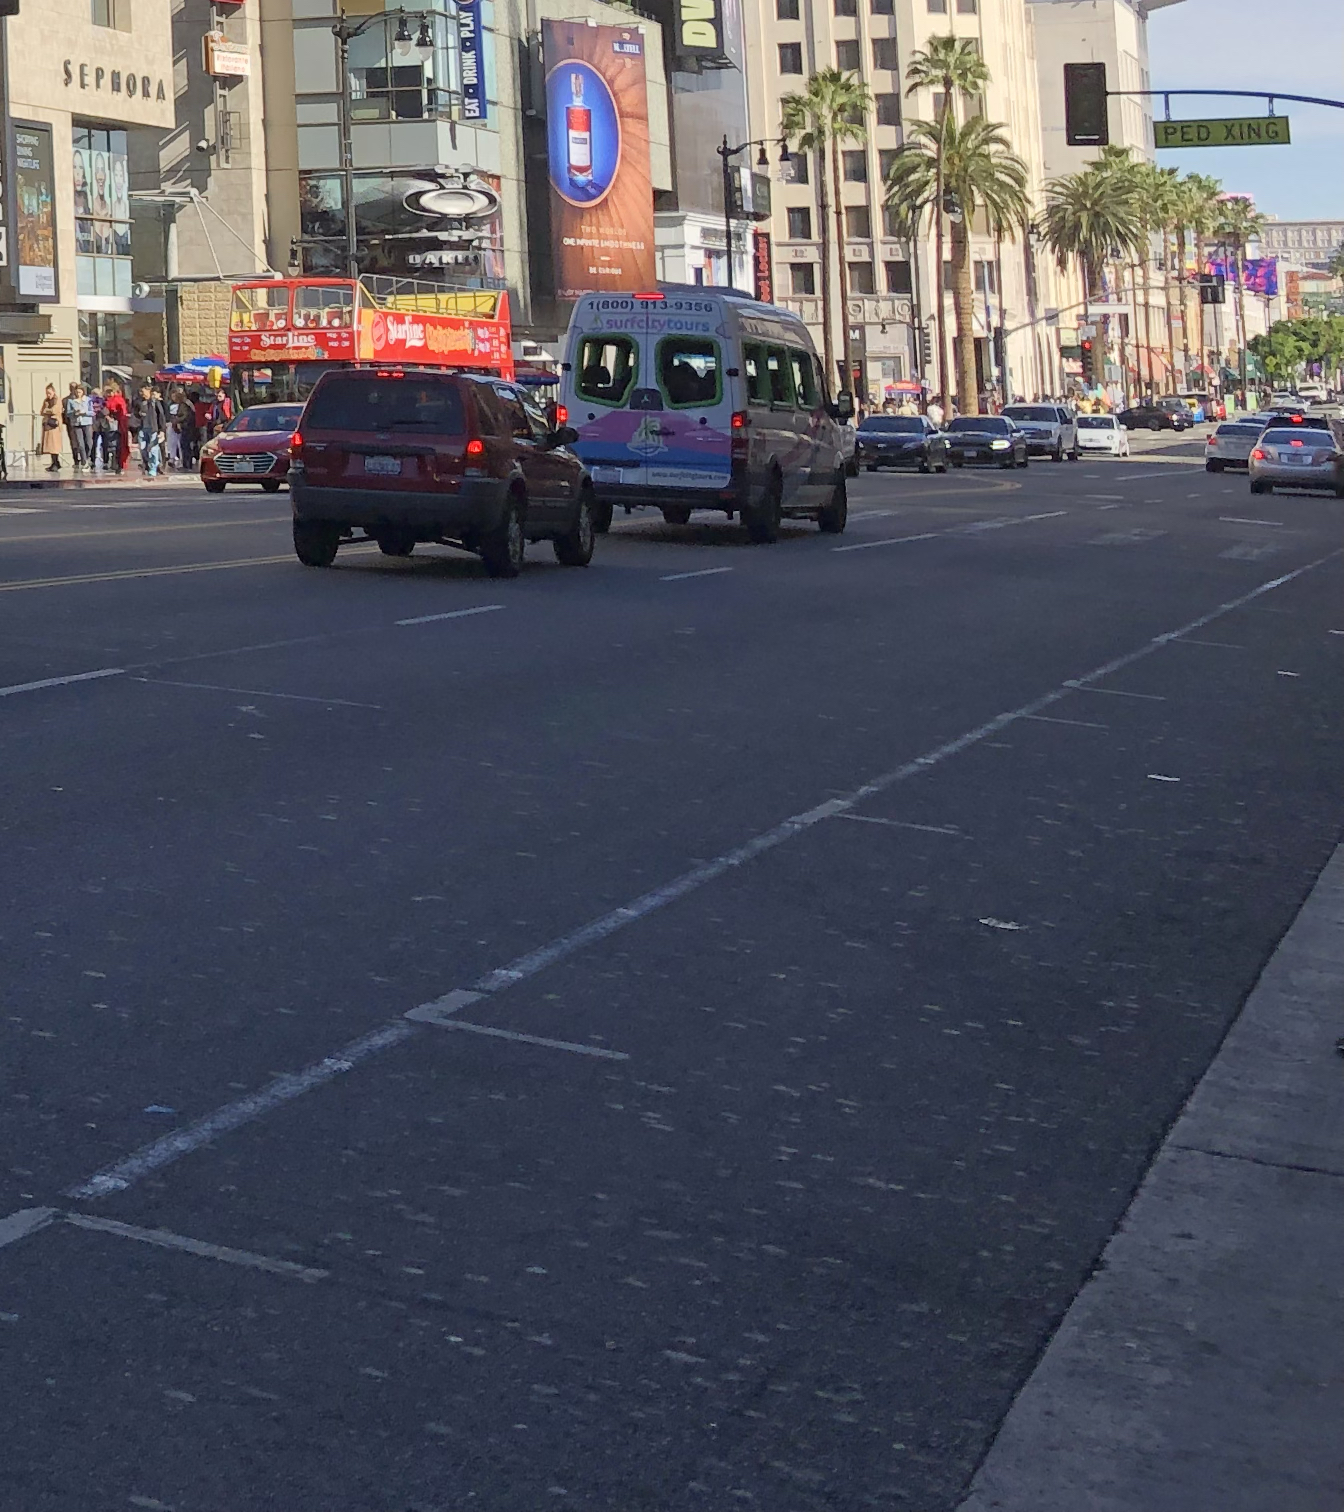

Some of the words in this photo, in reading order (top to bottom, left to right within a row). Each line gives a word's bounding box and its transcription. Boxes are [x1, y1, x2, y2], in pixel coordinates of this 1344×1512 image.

[459, 11, 475, 38] PLAY
[462, 50, 478, 85] DRINK
[63, 59, 166, 103] SEPHORA
[464, 97, 480, 118] EAT
[1163, 124, 1211, 143] PED
[1223, 121, 1279, 141] XING
[588, 300, 634, 311] 1(800)
[605, 315, 710, 332] surfcitytours
